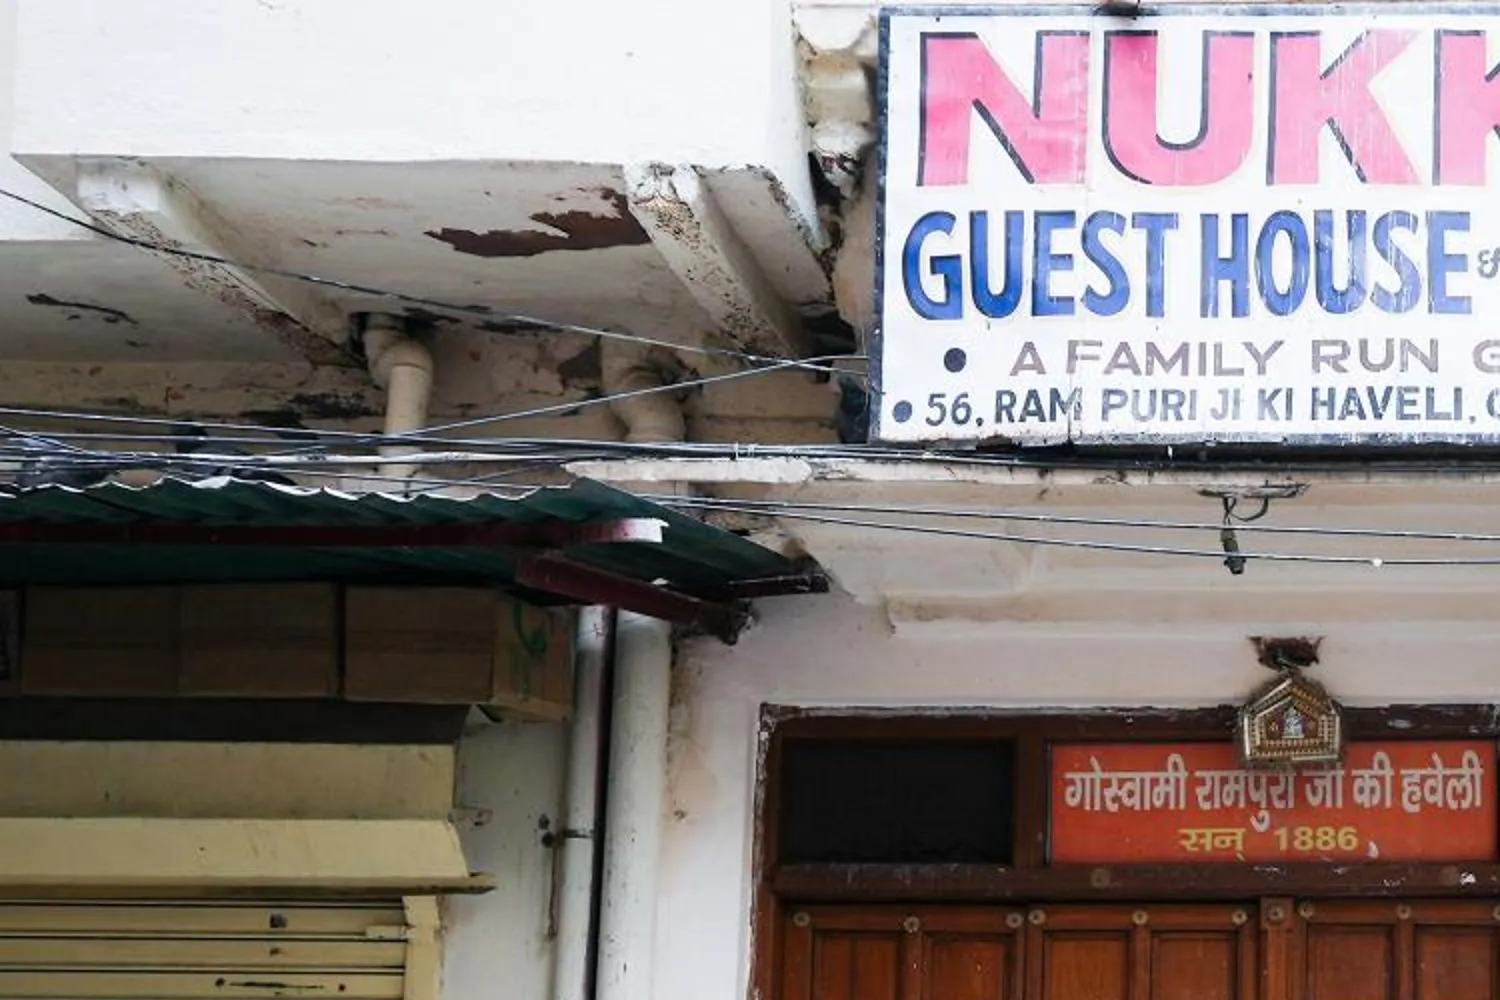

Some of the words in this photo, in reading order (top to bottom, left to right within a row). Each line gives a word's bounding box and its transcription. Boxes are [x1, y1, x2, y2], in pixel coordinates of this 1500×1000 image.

[902, 210, 1179, 320] GUEST
[1200, 209, 1473, 318] HOUSE
[1009, 341, 1047, 376] A
[1067, 339, 1284, 376] FAMILY
[1311, 338, 1438, 373] RUN
[994, 388, 1082, 423] RAM
[1102, 388, 1197, 422] PURI
[1210, 388, 1240, 421] JI
[1257, 388, 1293, 421] KI
[1064, 753, 1187, 812] गोस्वामी
[1353, 751, 1394, 810] की
[1401, 750, 1484, 812] हवेली
[1274, 827, 1359, 852] 1886
